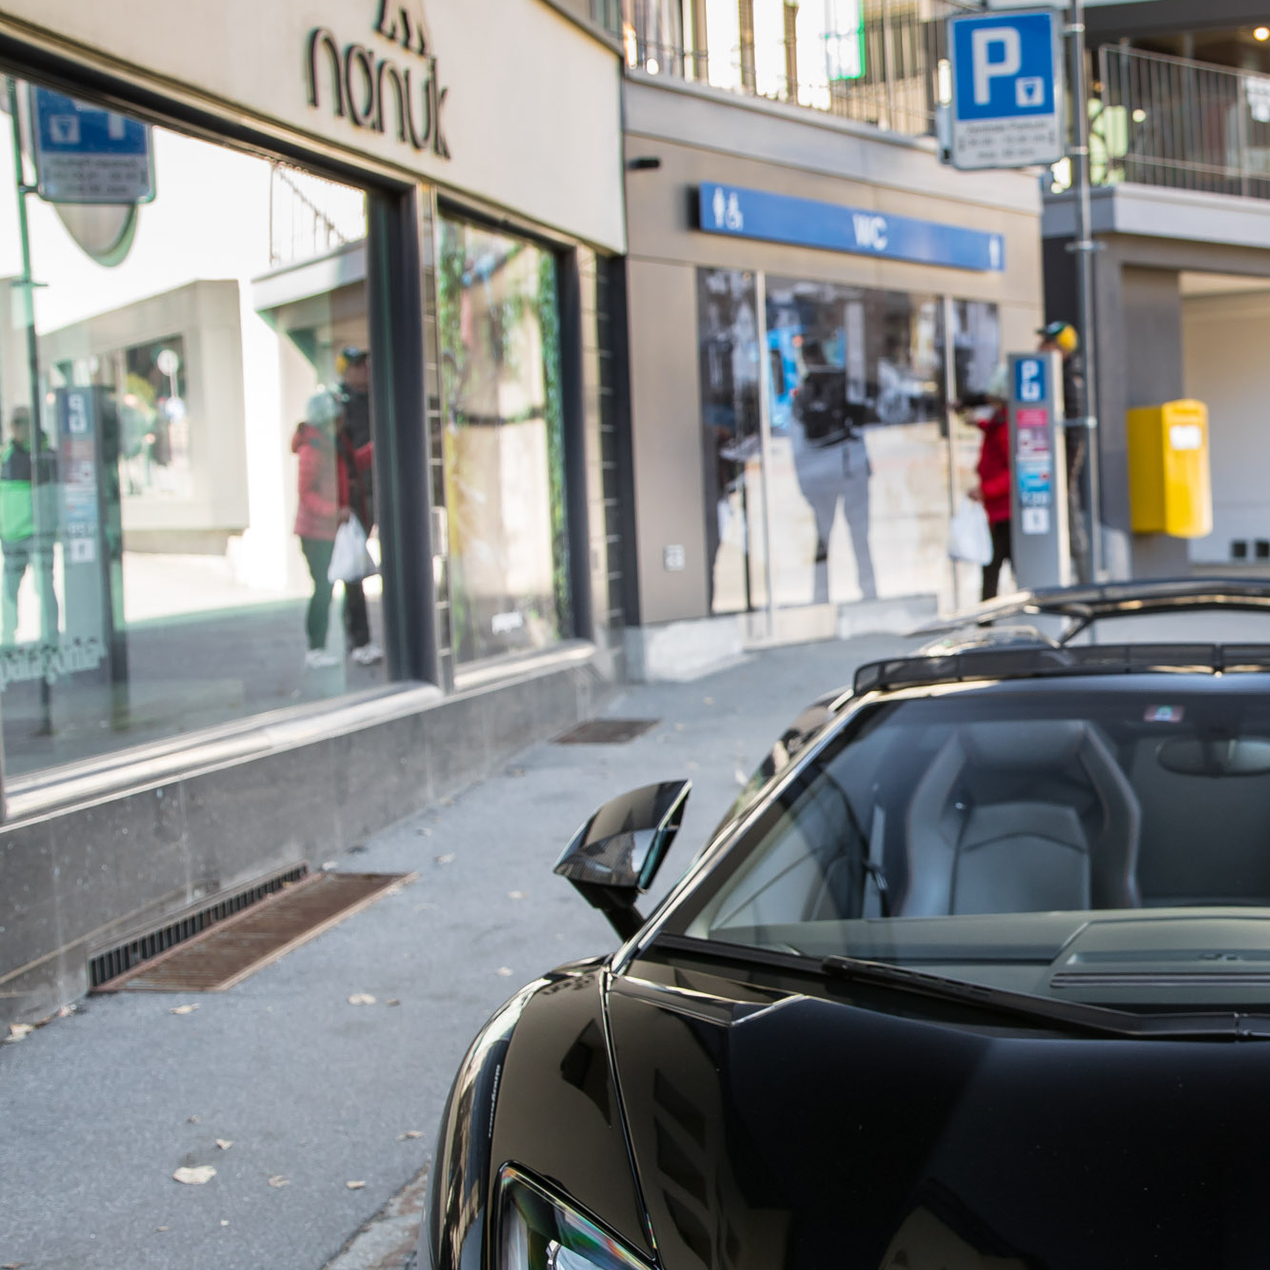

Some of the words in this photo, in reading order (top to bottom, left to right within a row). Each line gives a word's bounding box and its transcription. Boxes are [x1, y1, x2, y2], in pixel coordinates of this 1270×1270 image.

[307, 27, 452, 160] nanuk
[972, 26, 1022, 106] P
[852, 213, 888, 251] WC
